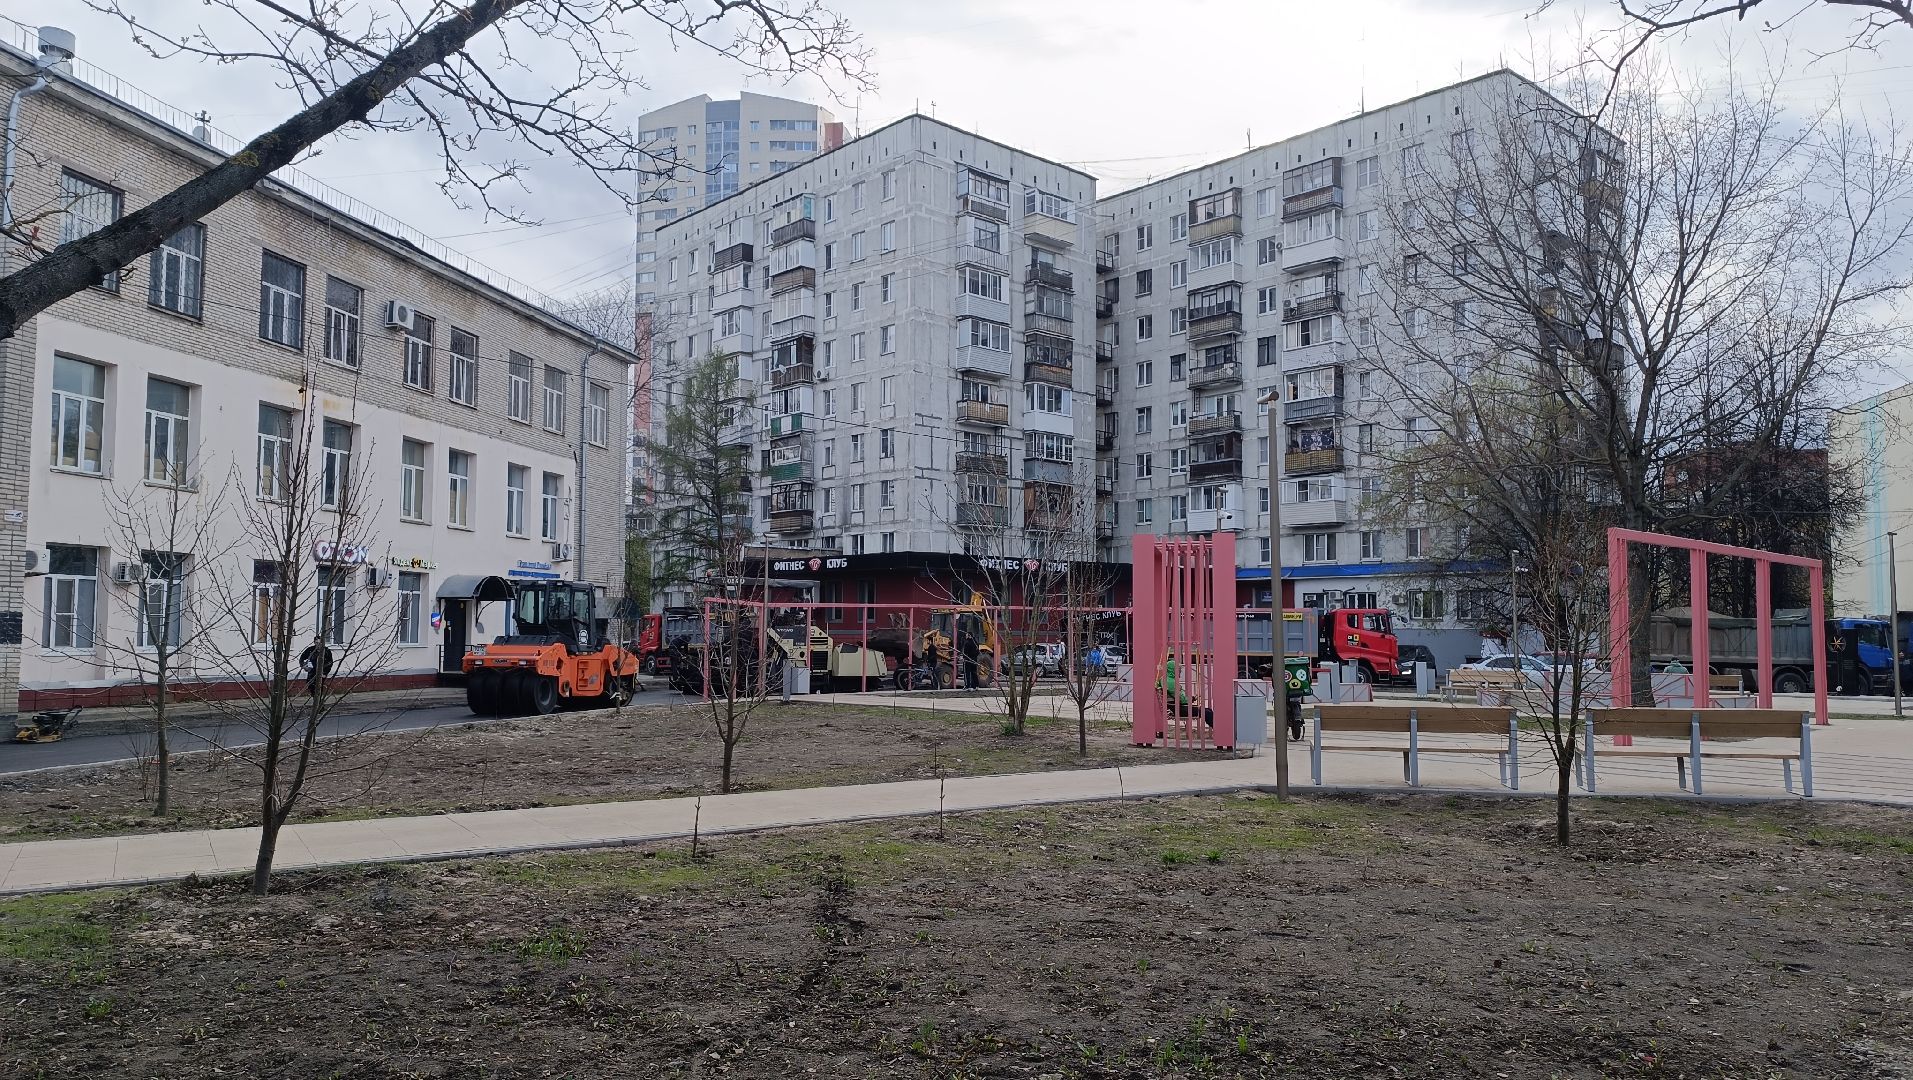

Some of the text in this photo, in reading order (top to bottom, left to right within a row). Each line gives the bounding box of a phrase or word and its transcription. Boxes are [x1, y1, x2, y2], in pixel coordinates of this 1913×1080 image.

[774, 558, 848, 571] ФИТНЕС КЛУБ
[980, 559, 1020, 571] ФИТНЕС
